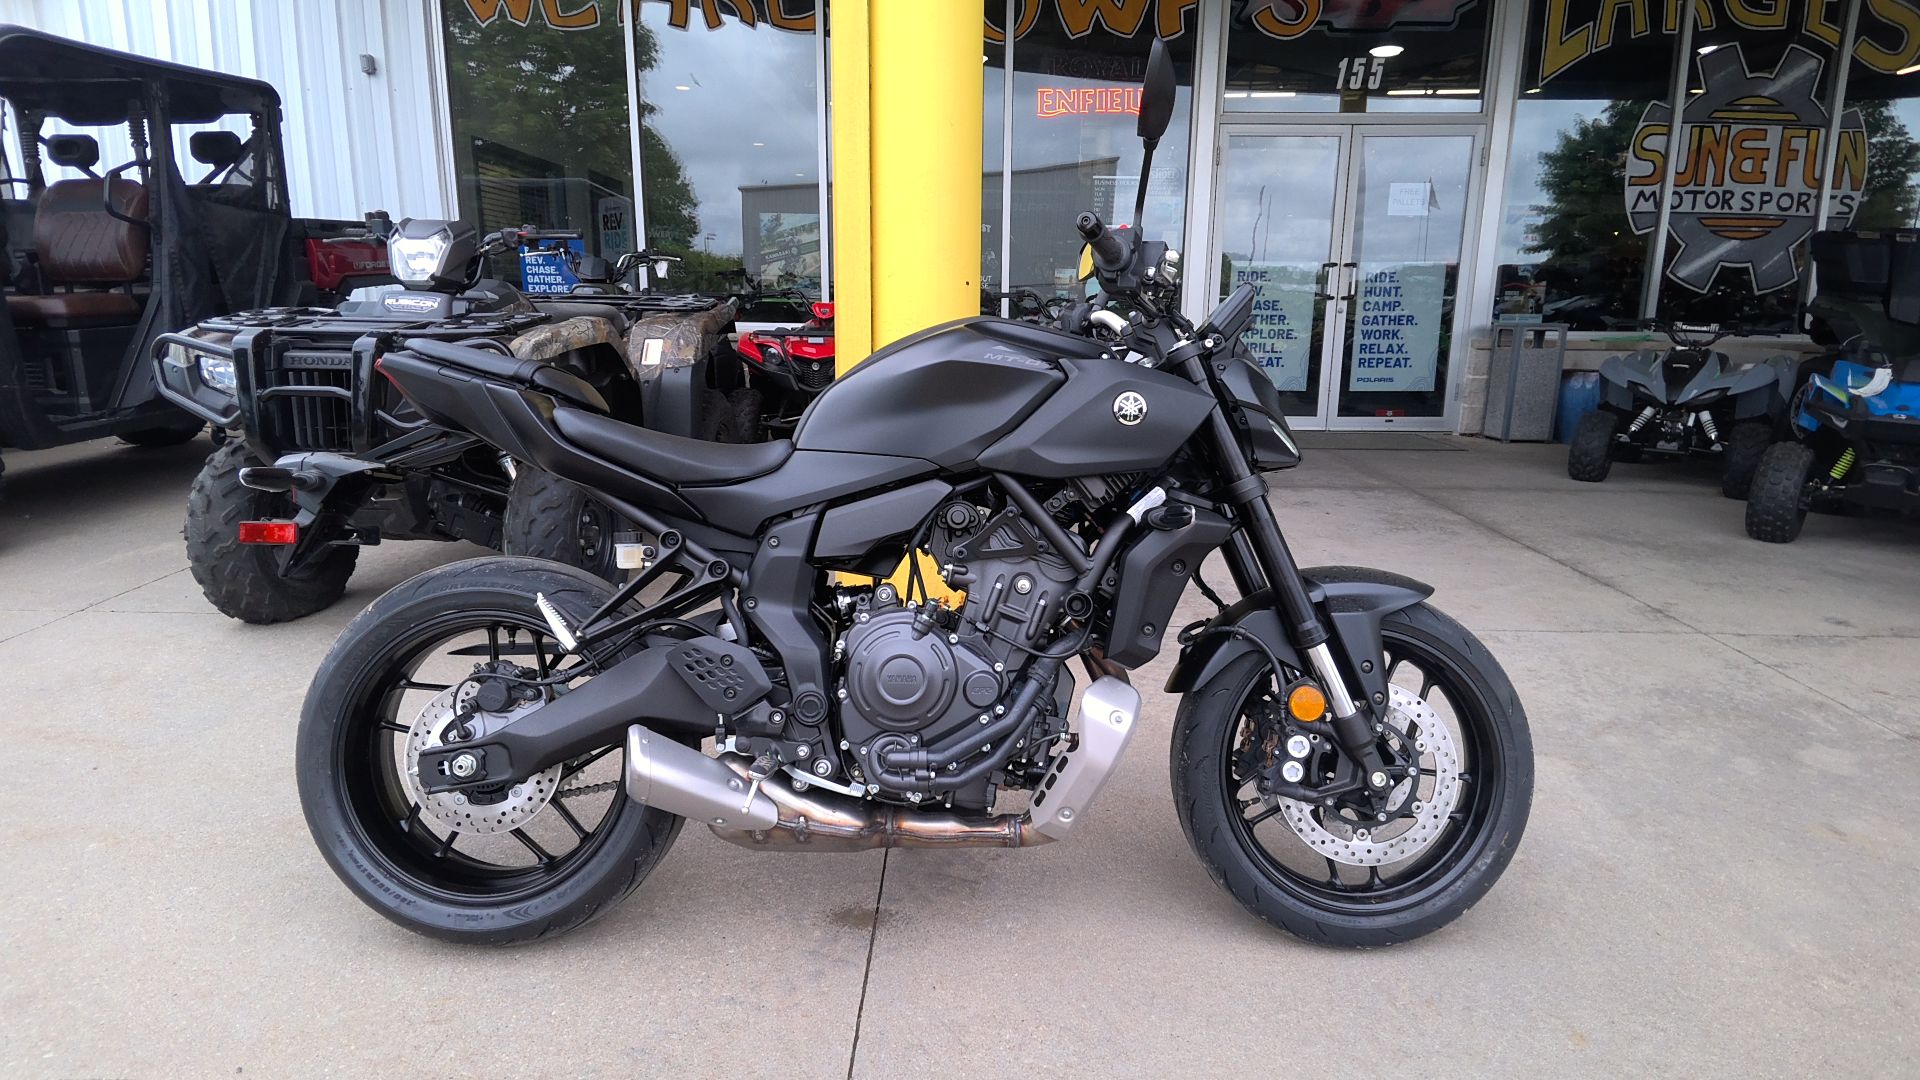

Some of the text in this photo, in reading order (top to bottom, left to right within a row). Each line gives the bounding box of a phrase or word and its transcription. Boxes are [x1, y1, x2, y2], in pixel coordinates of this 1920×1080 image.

[1336, 57, 1386, 90] 155
[1036, 87, 1144, 118] ENFIEL
[525, 255, 546, 265] REV.
[526, 265, 559, 274] CHASE.
[527, 275, 565, 284] GATHER.
[1237, 270, 1271, 283] RIDE.
[1365, 270, 1400, 284] RIDE.
[1363, 285, 1403, 298] HUNT.
[385, 298, 439, 309] RUBICON
[1253, 299, 1283, 312] ASE.
[1362, 300, 1405, 312] CAMP.
[1254, 314, 1290, 326] THER.
[1361, 314, 1419, 327] GATHER.
[1240, 328, 1298, 340] XPLORE.
[1360, 328, 1404, 341] WORK.
[1248, 342, 1283, 354] RILL.
[1359, 343, 1409, 355] RELAX.
[287, 355, 352, 367] HONDA
[983, 352, 1049, 368] MT-0
[1258, 356, 1285, 368] EAT.
[1357, 356, 1413, 369] REPEAT.
